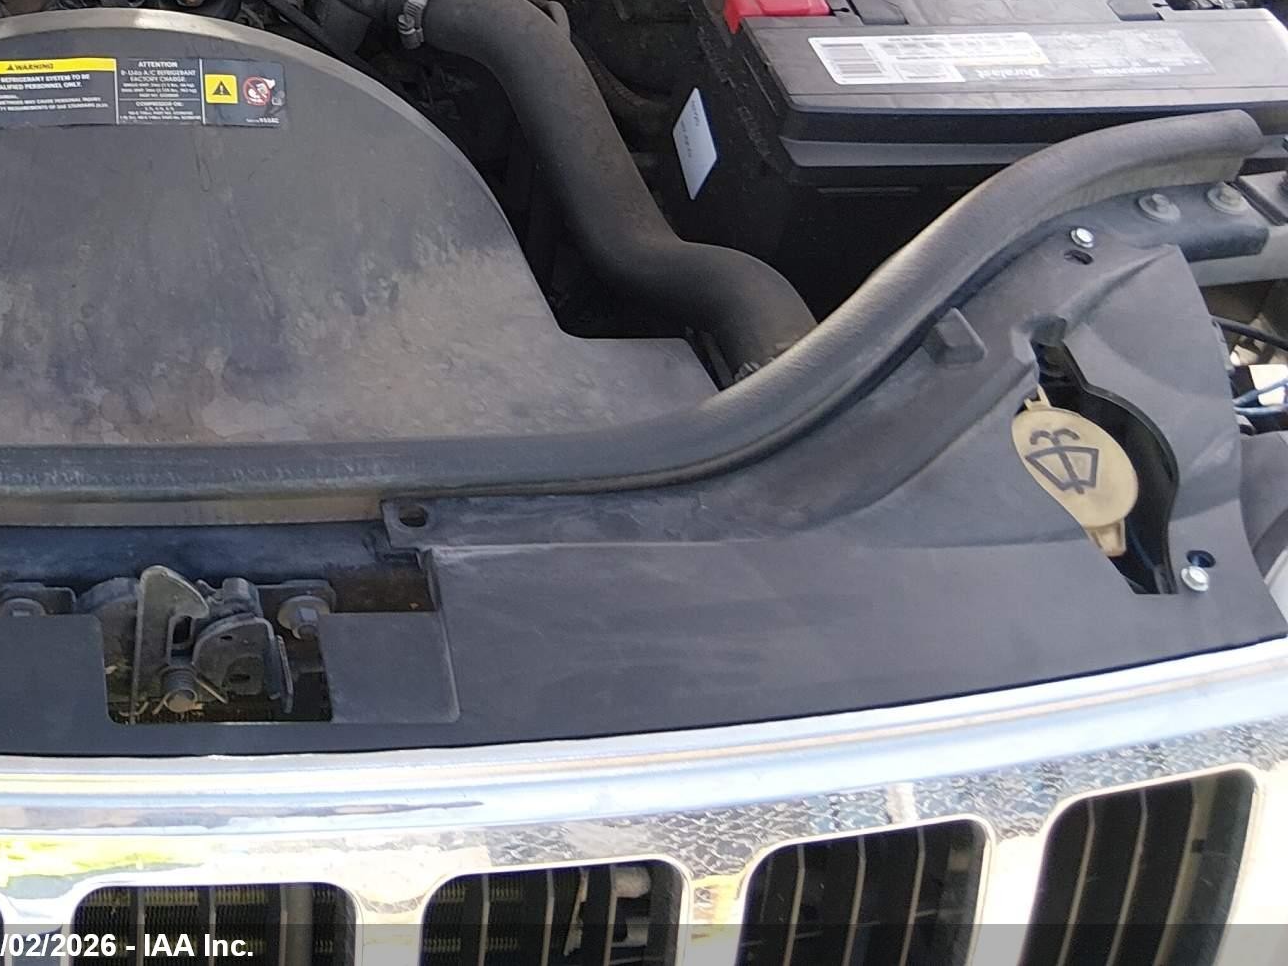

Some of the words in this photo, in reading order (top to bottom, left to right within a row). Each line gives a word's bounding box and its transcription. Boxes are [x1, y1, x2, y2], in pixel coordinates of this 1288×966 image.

[15, 63, 54, 71] WARNING
[976, 66, 1041, 79] Duralast
[72, 73, 81, 81] TO
[23, 82, 63, 90] PERSONNEL
